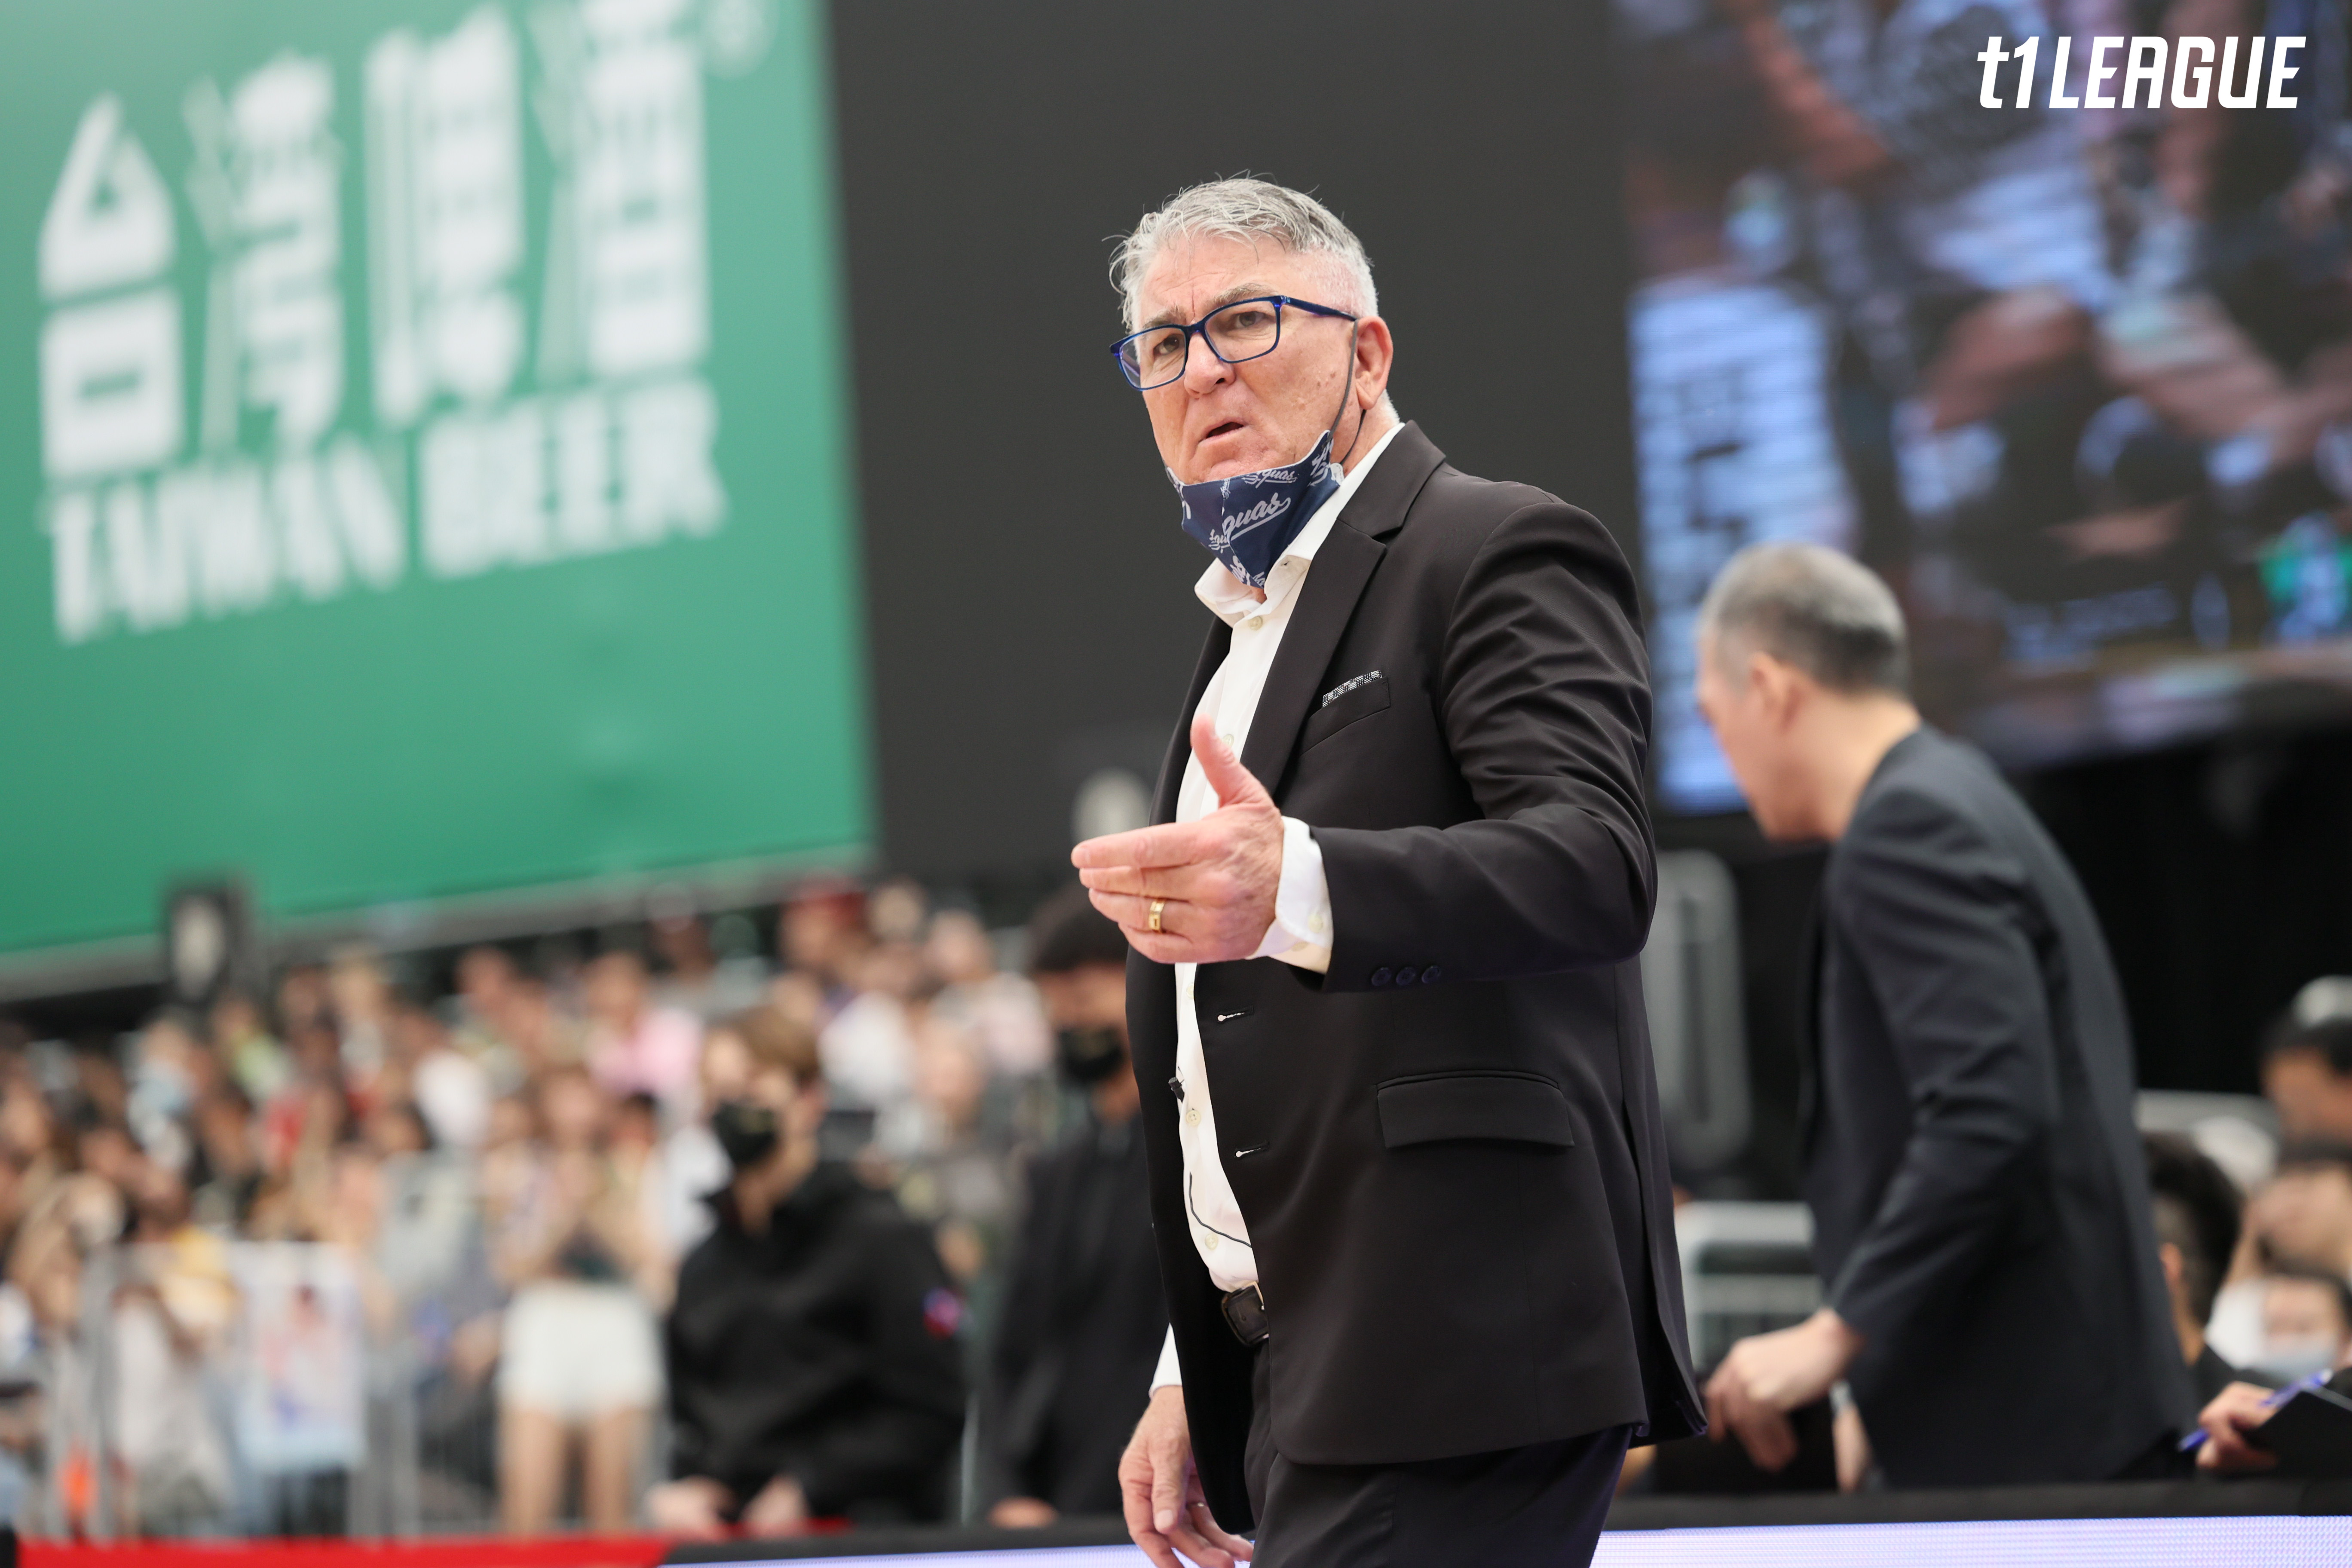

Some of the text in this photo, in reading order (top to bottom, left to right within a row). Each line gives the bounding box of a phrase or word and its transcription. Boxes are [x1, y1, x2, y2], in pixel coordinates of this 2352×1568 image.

[41, 378, 729, 643] TAIWAN BEER
[1222, 492, 1291, 542] quas
